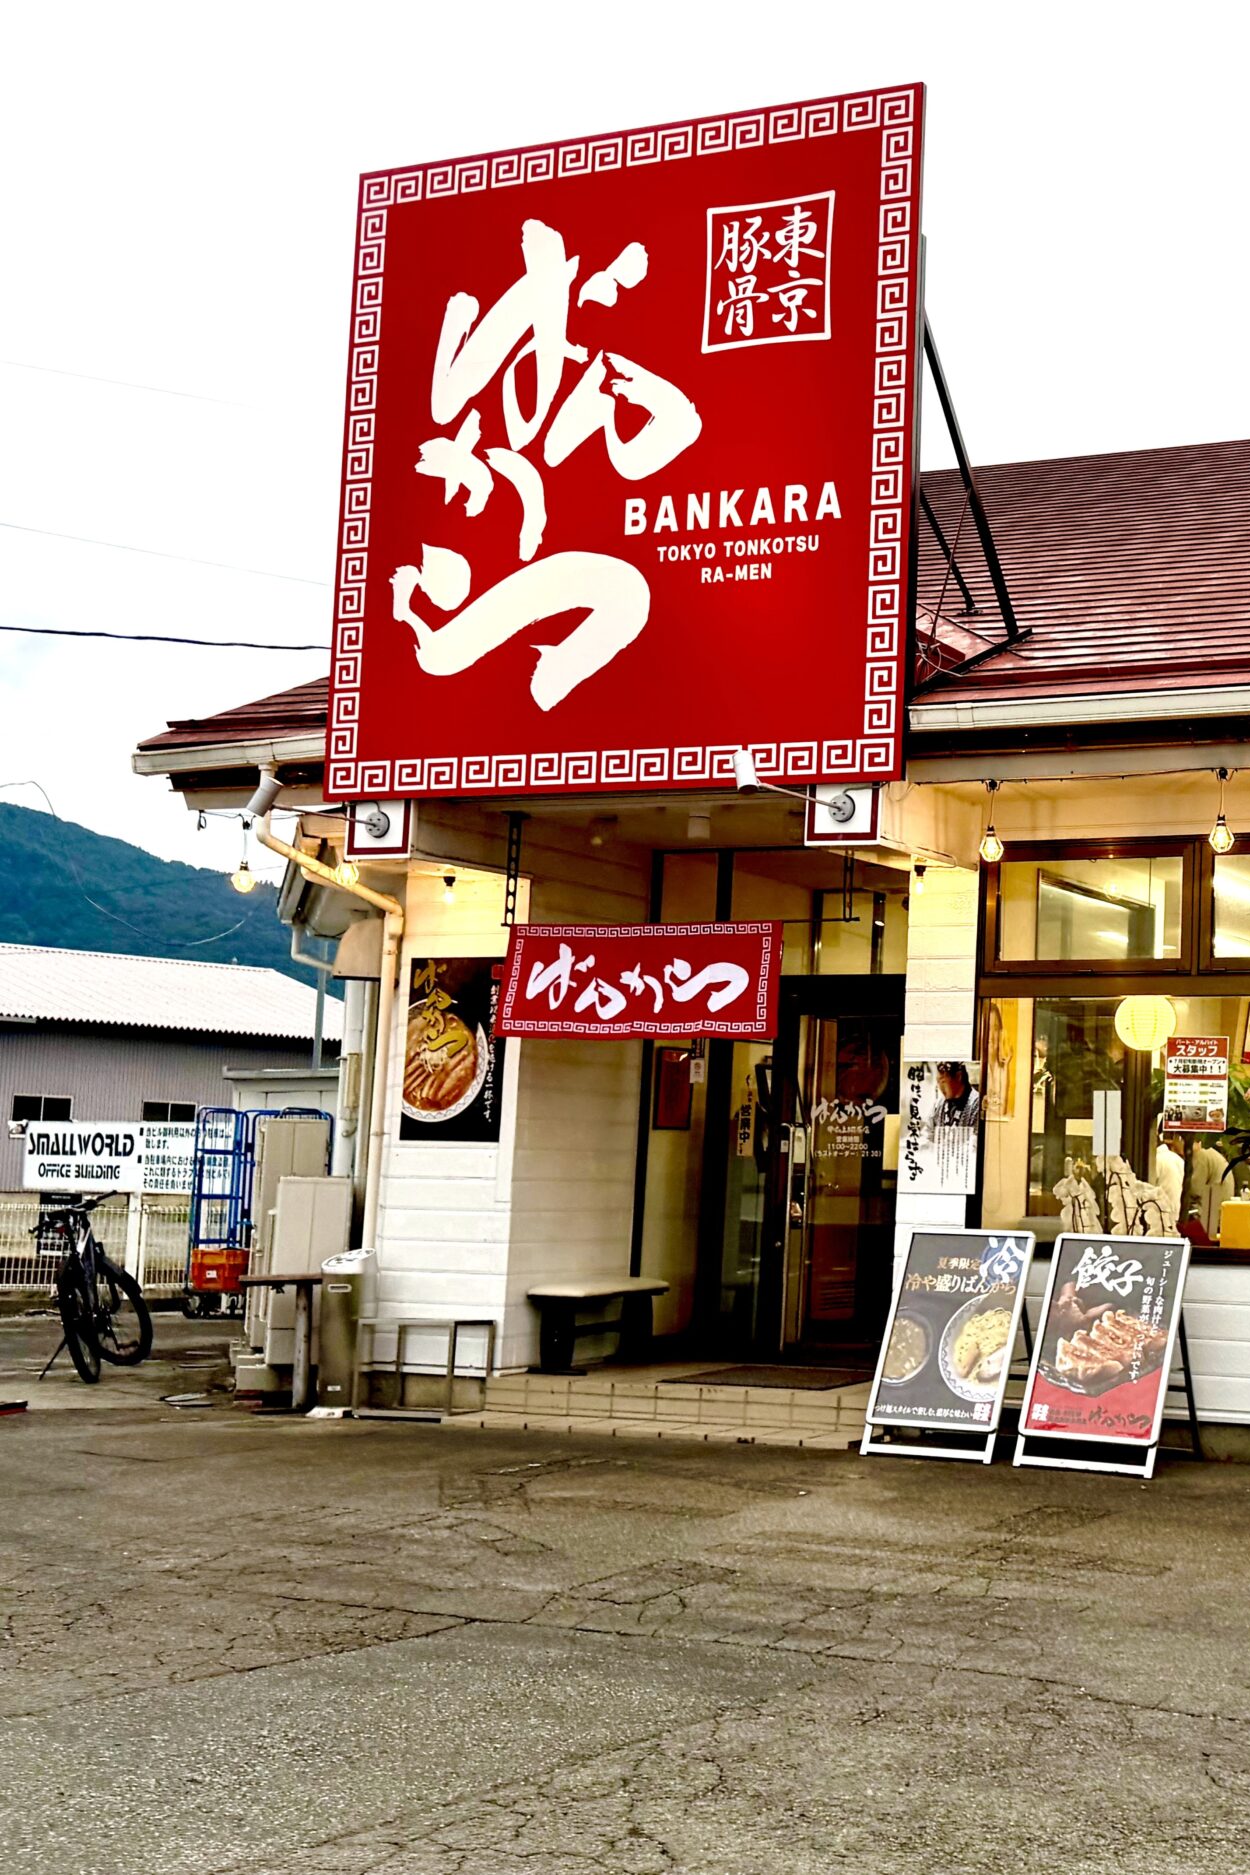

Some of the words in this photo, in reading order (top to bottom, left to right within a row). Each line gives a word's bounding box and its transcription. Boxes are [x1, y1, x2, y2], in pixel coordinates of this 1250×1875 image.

[389, 218, 703, 713] ばんから
[623, 481, 843, 536] BANKARA
[657, 540, 717, 563] TOKYO
[723, 534, 821, 557] TONKOTSU
[700, 562, 774, 585] RA-MEN
[526, 943, 750, 1020] ばんから
[1175, 1045, 1219, 1056] スタッフ
[1071, 1245, 1145, 1297] 餃子
